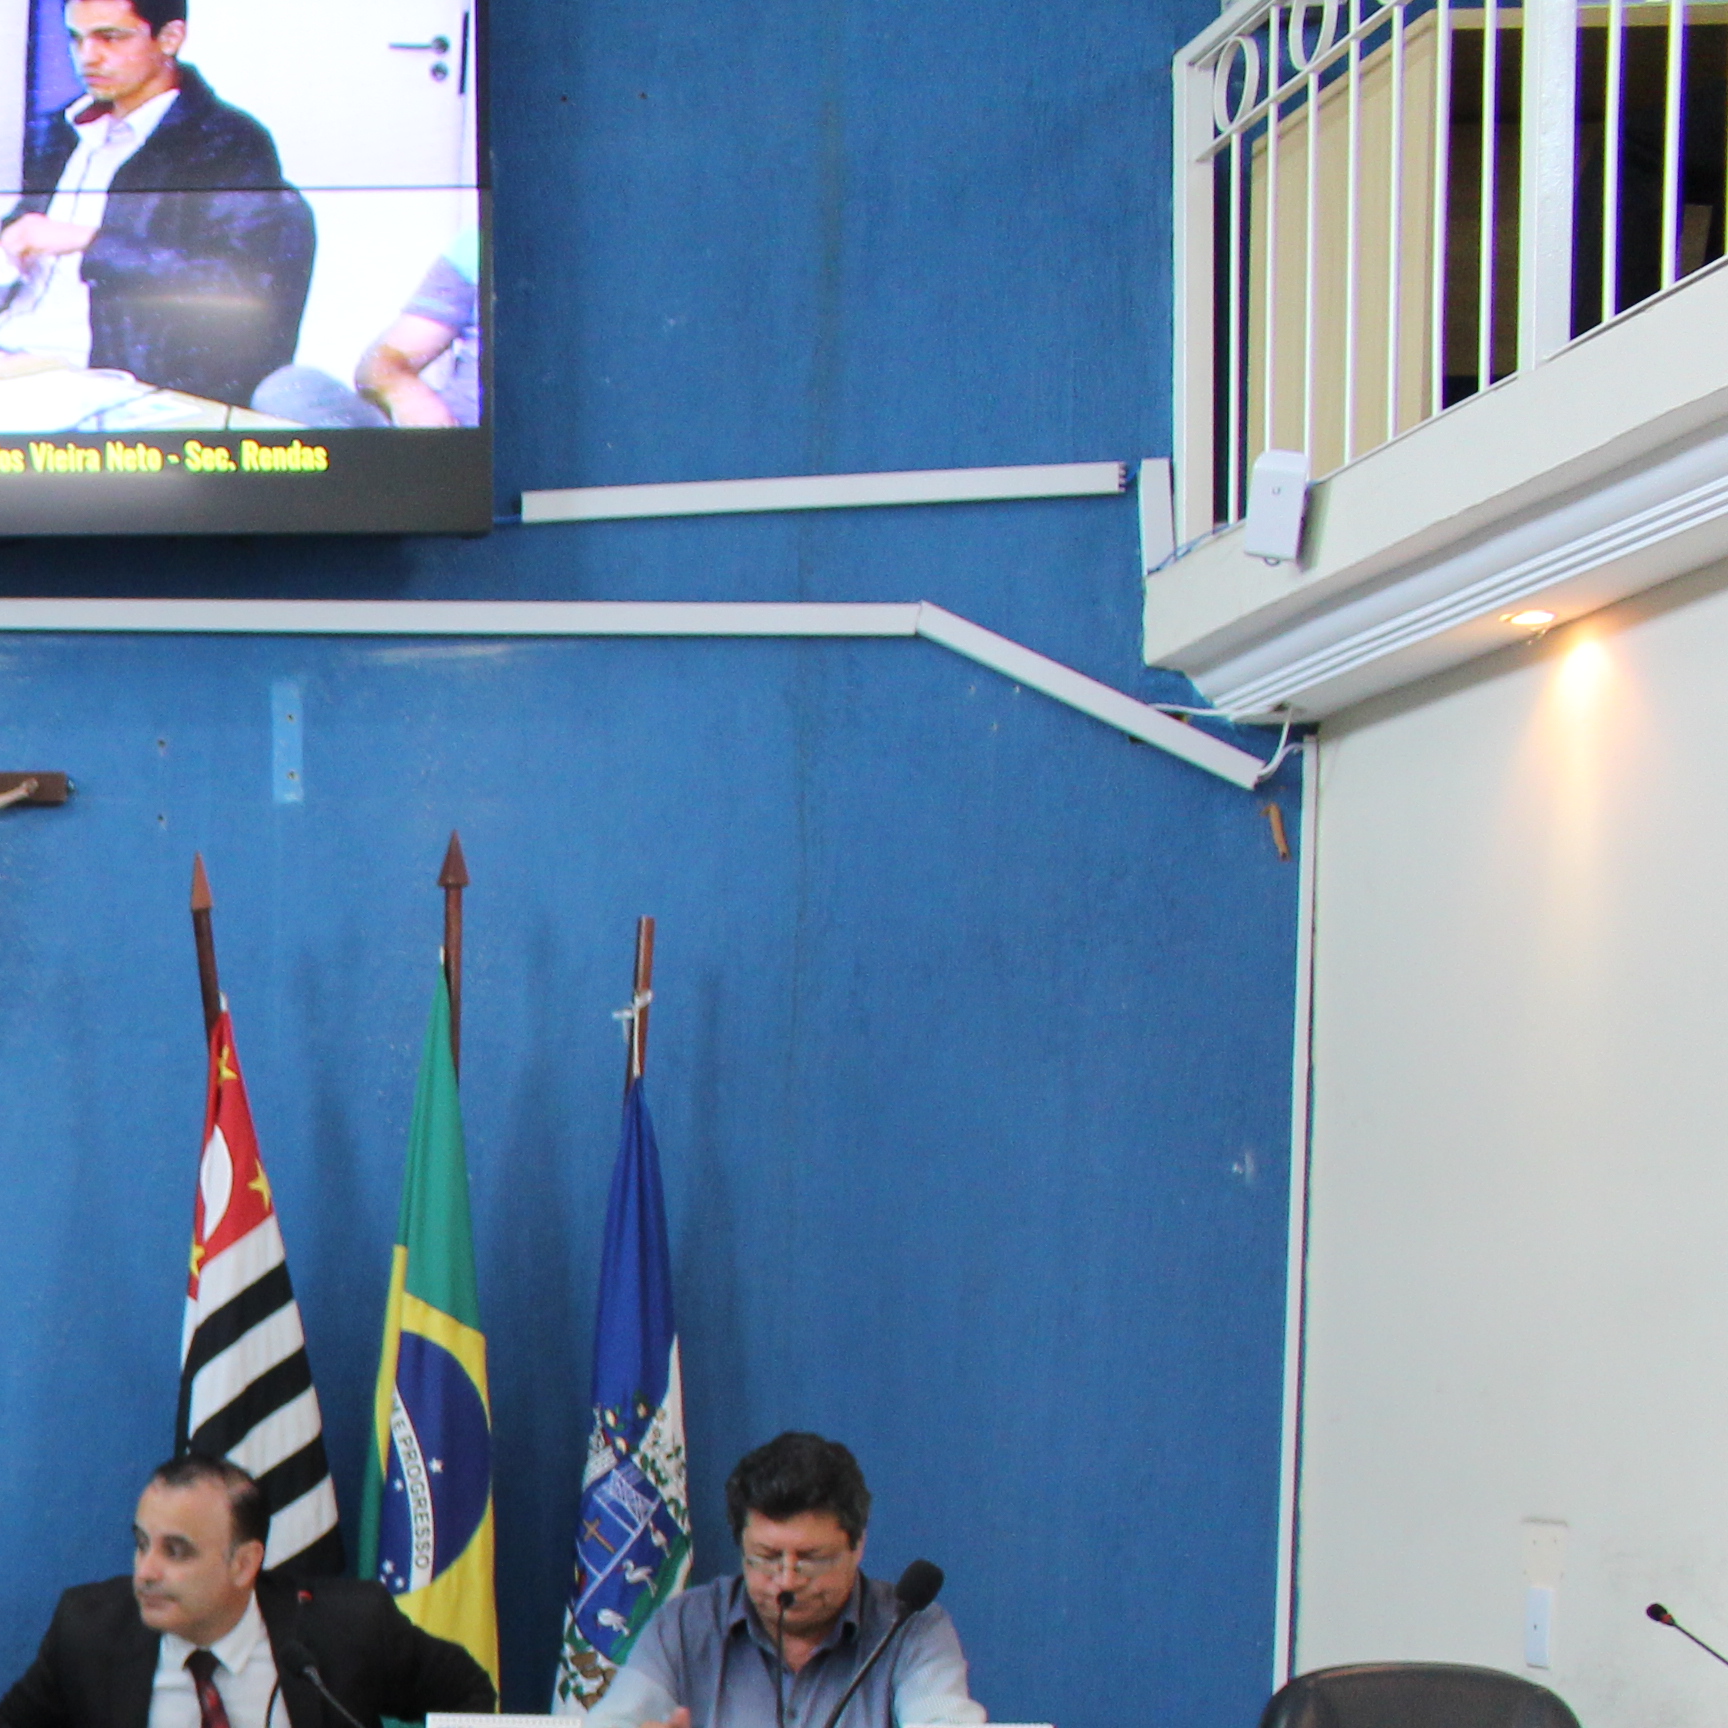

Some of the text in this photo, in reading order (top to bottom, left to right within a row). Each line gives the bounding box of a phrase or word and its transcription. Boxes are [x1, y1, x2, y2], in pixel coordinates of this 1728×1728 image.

[29, 441, 101, 472] Vieira
[105, 441, 163, 472] Neto
[183, 440, 237, 472] Sec.
[241, 439, 329, 472] Rendas
